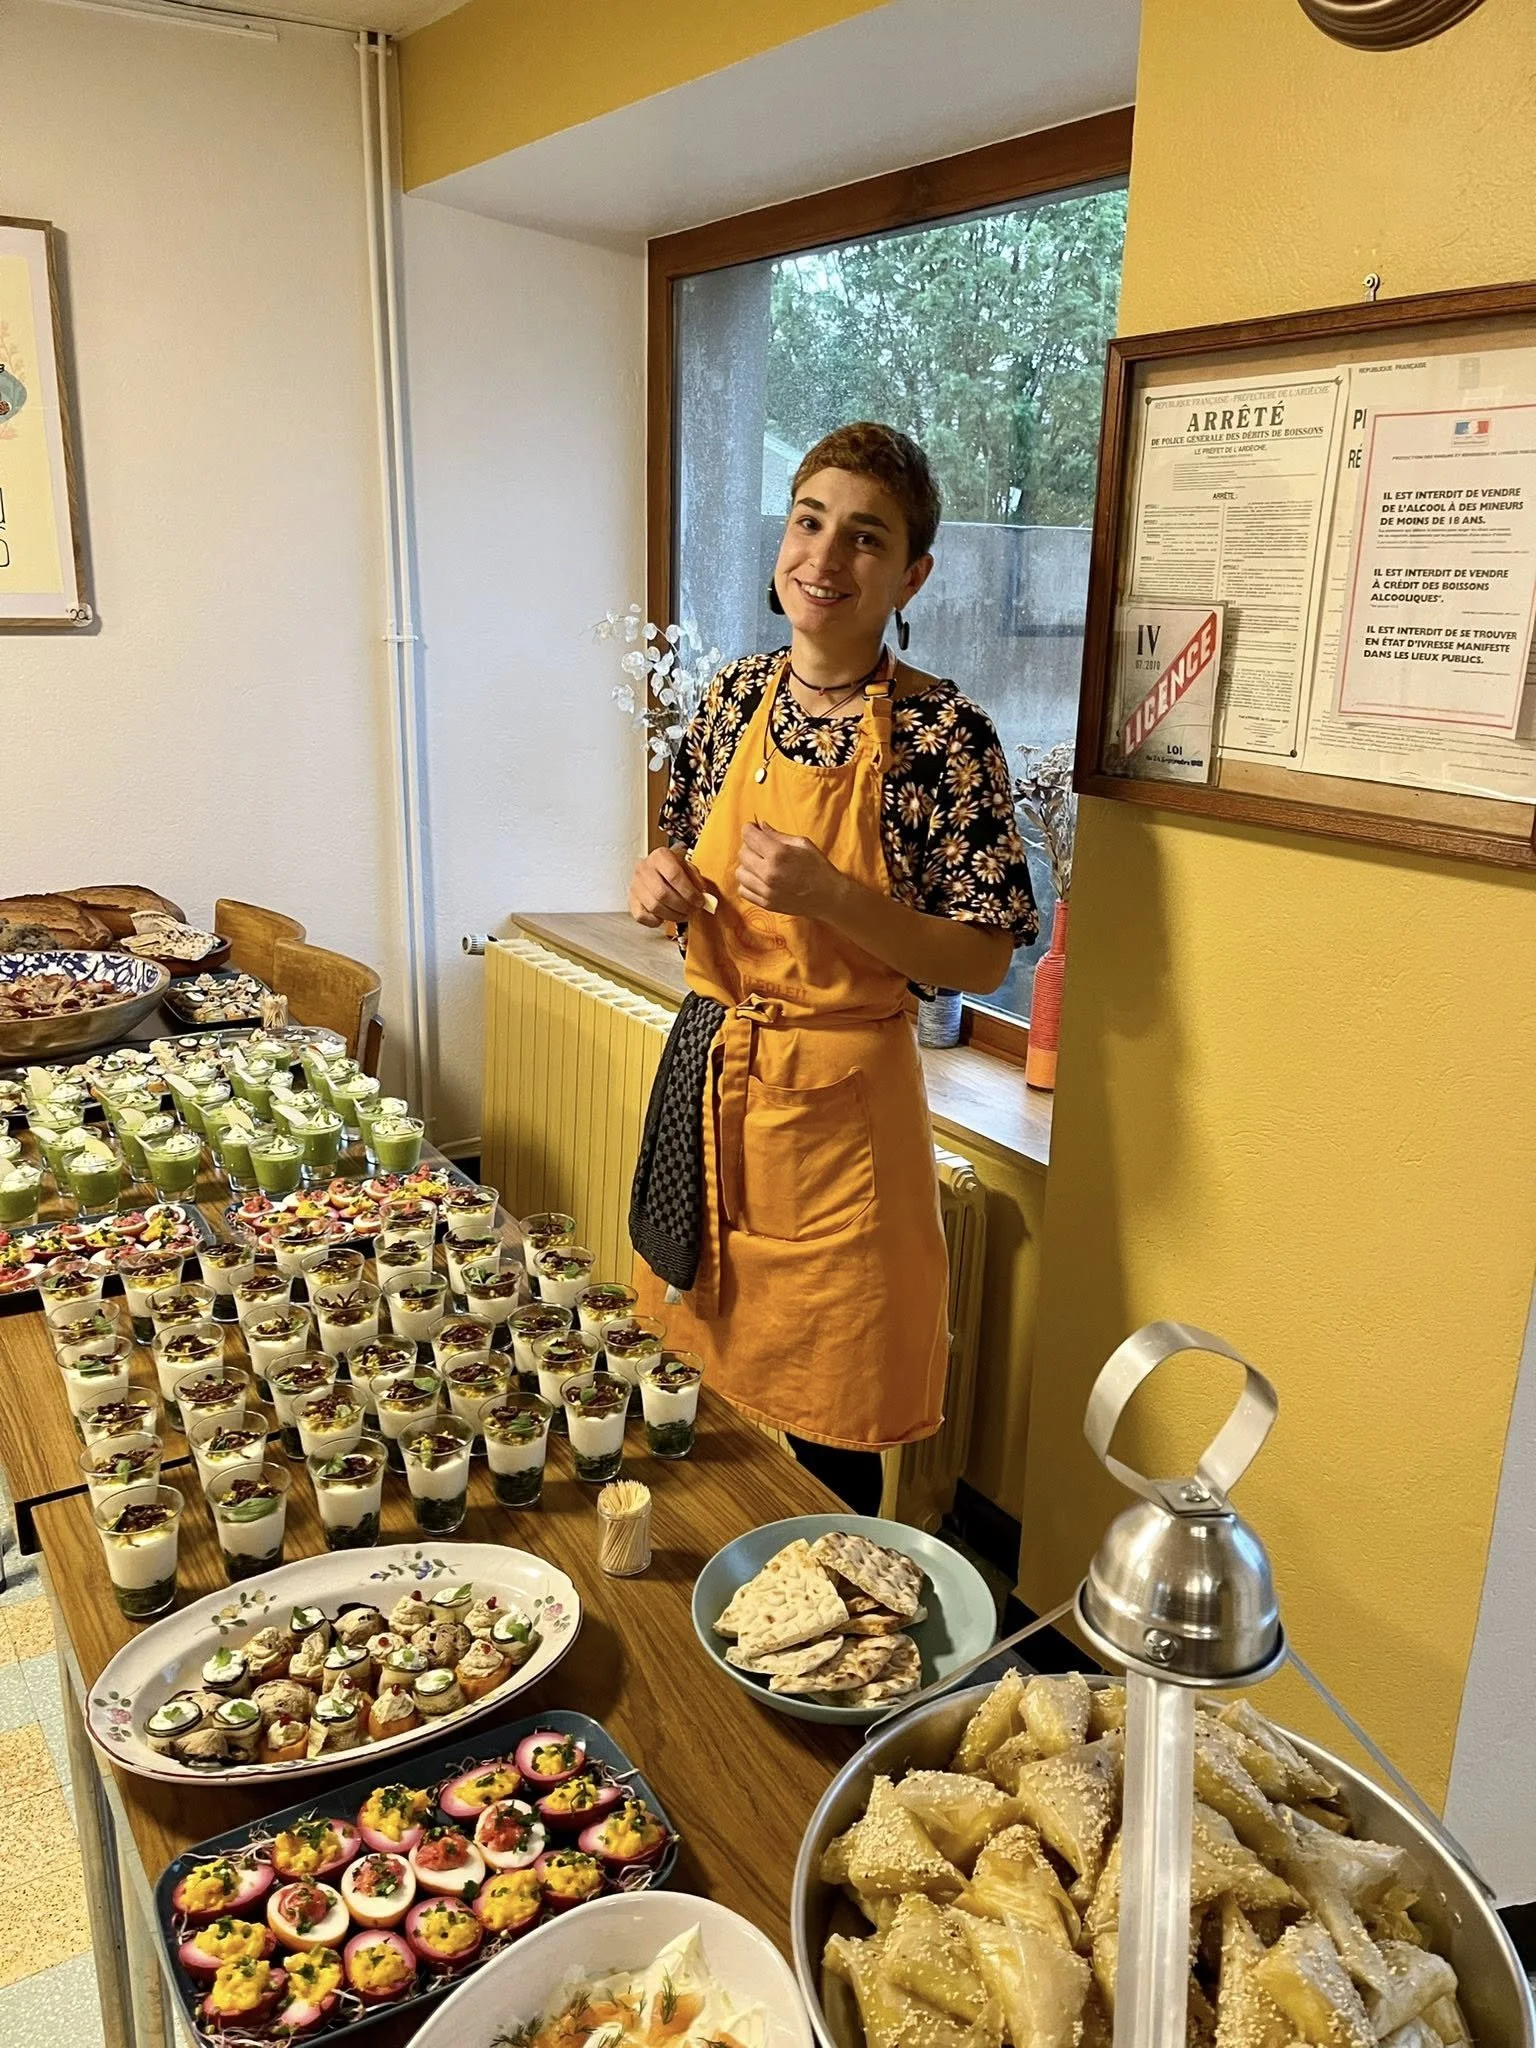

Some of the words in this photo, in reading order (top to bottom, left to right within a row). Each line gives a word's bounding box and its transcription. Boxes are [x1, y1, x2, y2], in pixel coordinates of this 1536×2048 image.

[1186, 400, 1286, 433] ARRÊTÉ
[1151, 438, 1160, 446] DE
[1161, 436, 1185, 446] POLICE
[1225, 432, 1240, 441] DES
[1242, 429, 1270, 440] DÉBITS
[1271, 429, 1283, 438] DE
[1284, 426, 1325, 437] BOISSONS
[1383, 492, 1392, 500] IL
[1395, 491, 1413, 500] EST
[1415, 490, 1464, 500] INTERDIT
[1465, 489, 1479, 498] DE
[1481, 488, 1522, 498] VENDRE
[1382, 504, 1396, 513] DE
[1398, 503, 1446, 513] L'ALCOOL
[1447, 501, 1456, 512] À
[1459, 502, 1477, 511] DES
[1479, 501, 1524, 511] MINEURS
[1380, 517, 1394, 526] DE
[1396, 516, 1430, 526] MOINS
[1432, 516, 1446, 525] DE
[1448, 516, 1460, 525] 18
[1462, 516, 1486, 525] ANS.
[1373, 568, 1383, 577] IL
[1385, 568, 1403, 577] EST
[1404, 568, 1452, 577] INTERDIT
[1454, 569, 1467, 578] DE
[1469, 569, 1509, 579] VENDRE
[1372, 579, 1381, 589] À
[1383, 580, 1420, 590] CRÉDIT
[1422, 581, 1440, 590] DES
[1442, 582, 1490, 591] BOISSONS
[1366, 625, 1376, 634] IL
[1378, 626, 1395, 635] EST
[1397, 627, 1443, 637] INTERDIT
[1445, 629, 1458, 637] DE
[1459, 629, 1472, 638] SE
[1473, 630, 1518, 640] TROUVER
[1137, 624, 1161, 657] IV
[1365, 638, 1380, 646] EN
[1382, 637, 1406, 648] ÉTAT
[1407, 639, 1455, 650] D'IVRESSE
[1456, 642, 1511, 653] MANIFESTE
[1363, 650, 1392, 659] DANS
[1394, 651, 1409, 660] LES
[1411, 652, 1439, 662] LIEUX
[1441, 654, 1484, 664] PUBLICS.
[1125, 622, 1213, 755] LICENCE
[1167, 745, 1183, 756] LOI
